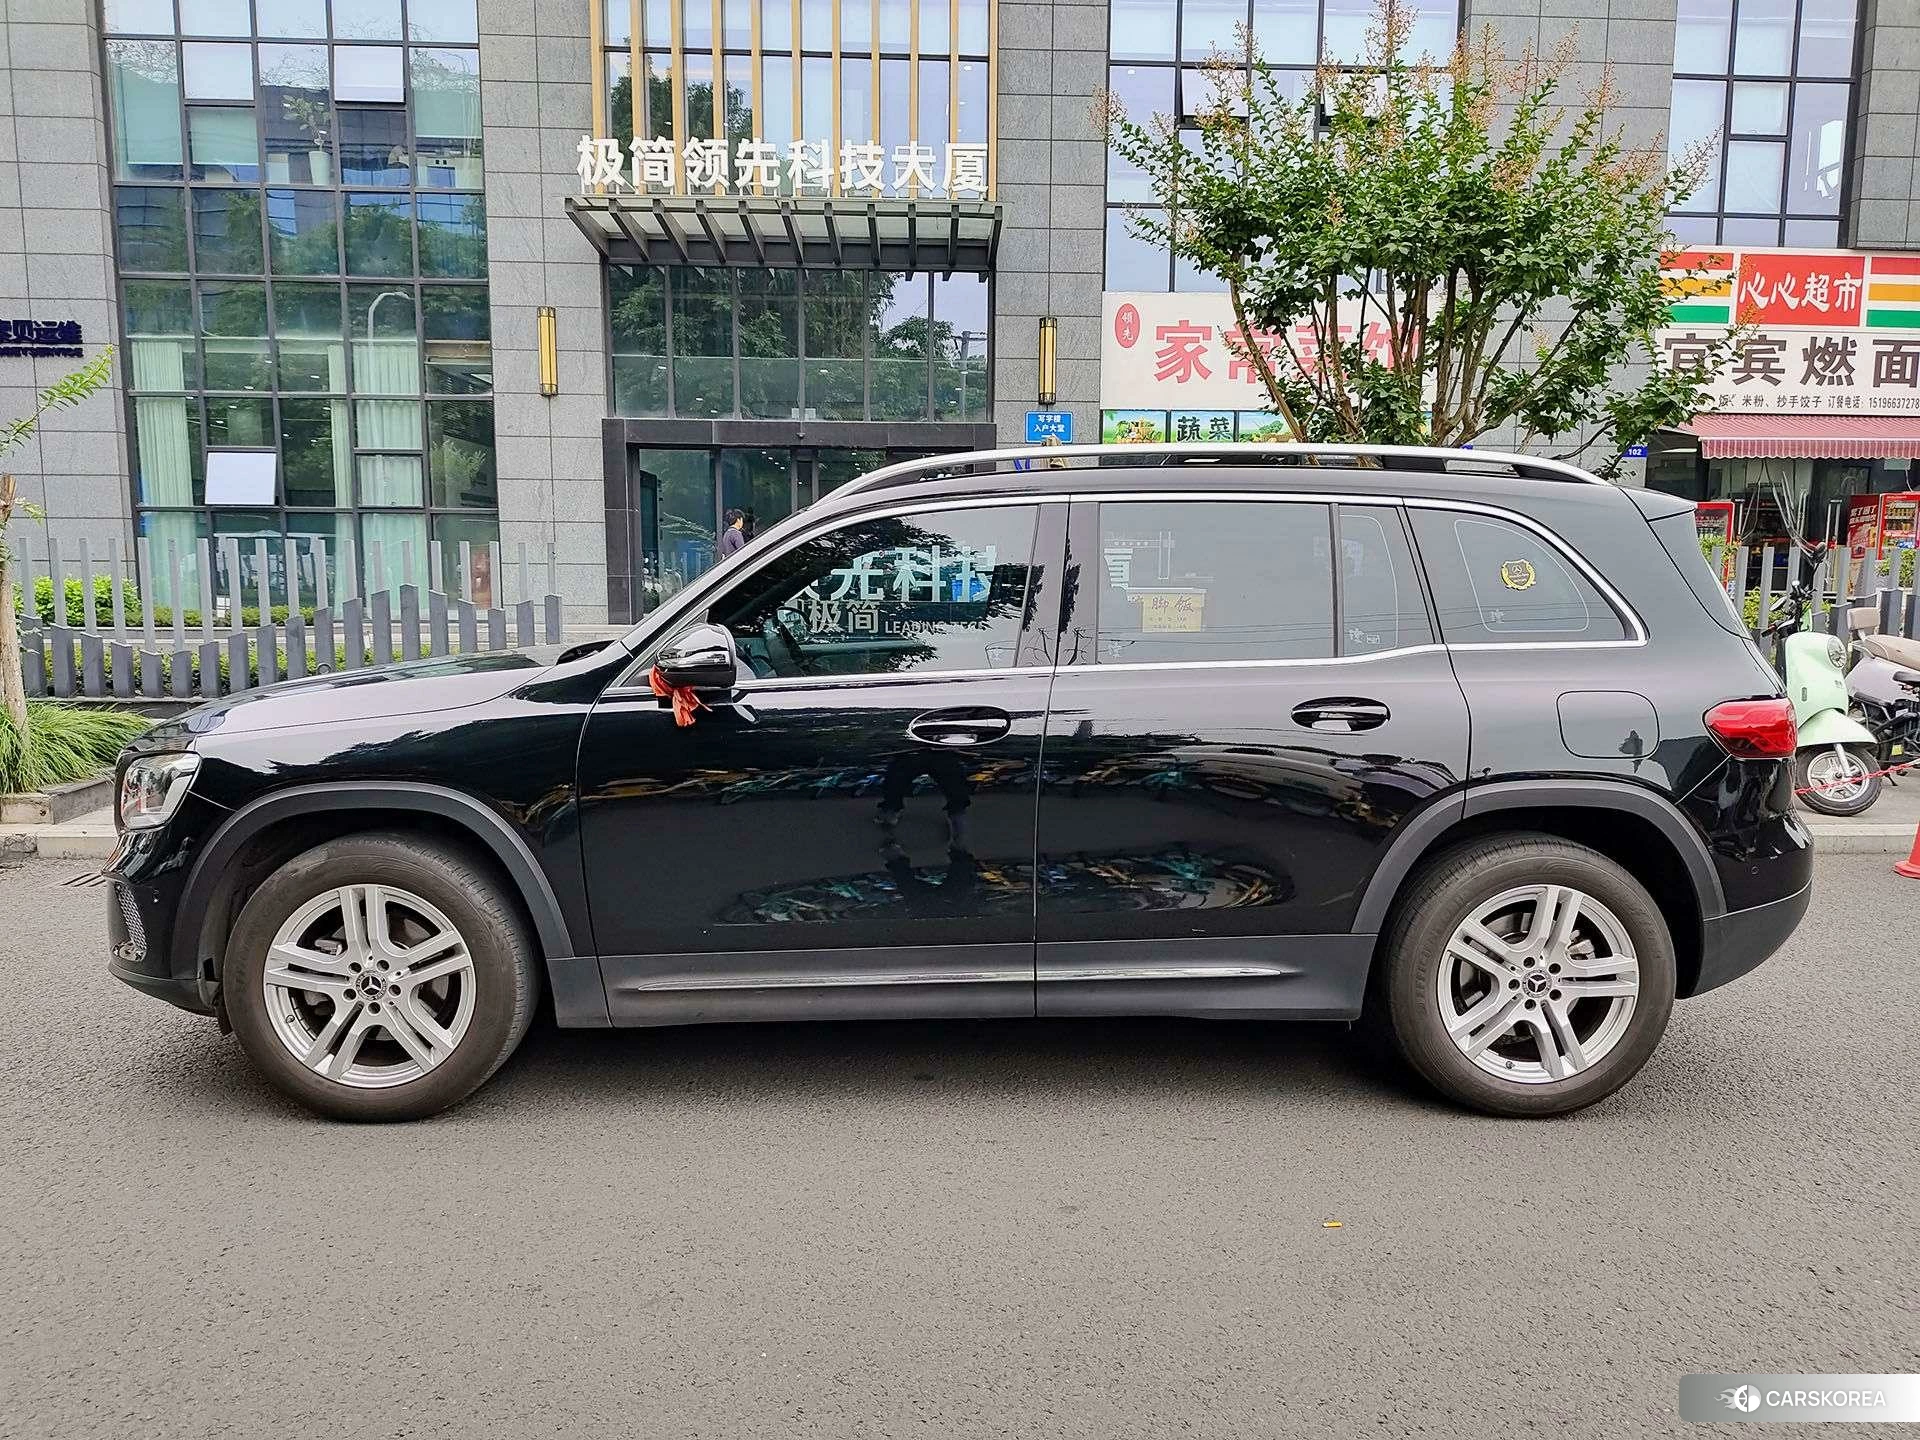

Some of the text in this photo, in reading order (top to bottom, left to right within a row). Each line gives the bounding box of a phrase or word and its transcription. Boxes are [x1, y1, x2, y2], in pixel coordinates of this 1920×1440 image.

[577, 135, 989, 193] 极简领先科技大厦
[1740, 271, 1862, 312] 心心超市
[1663, 333, 1920, 388] 宜宾燃面
[1177, 415, 1232, 441] 蔬菜
[1628, 448, 1642, 456] 102
